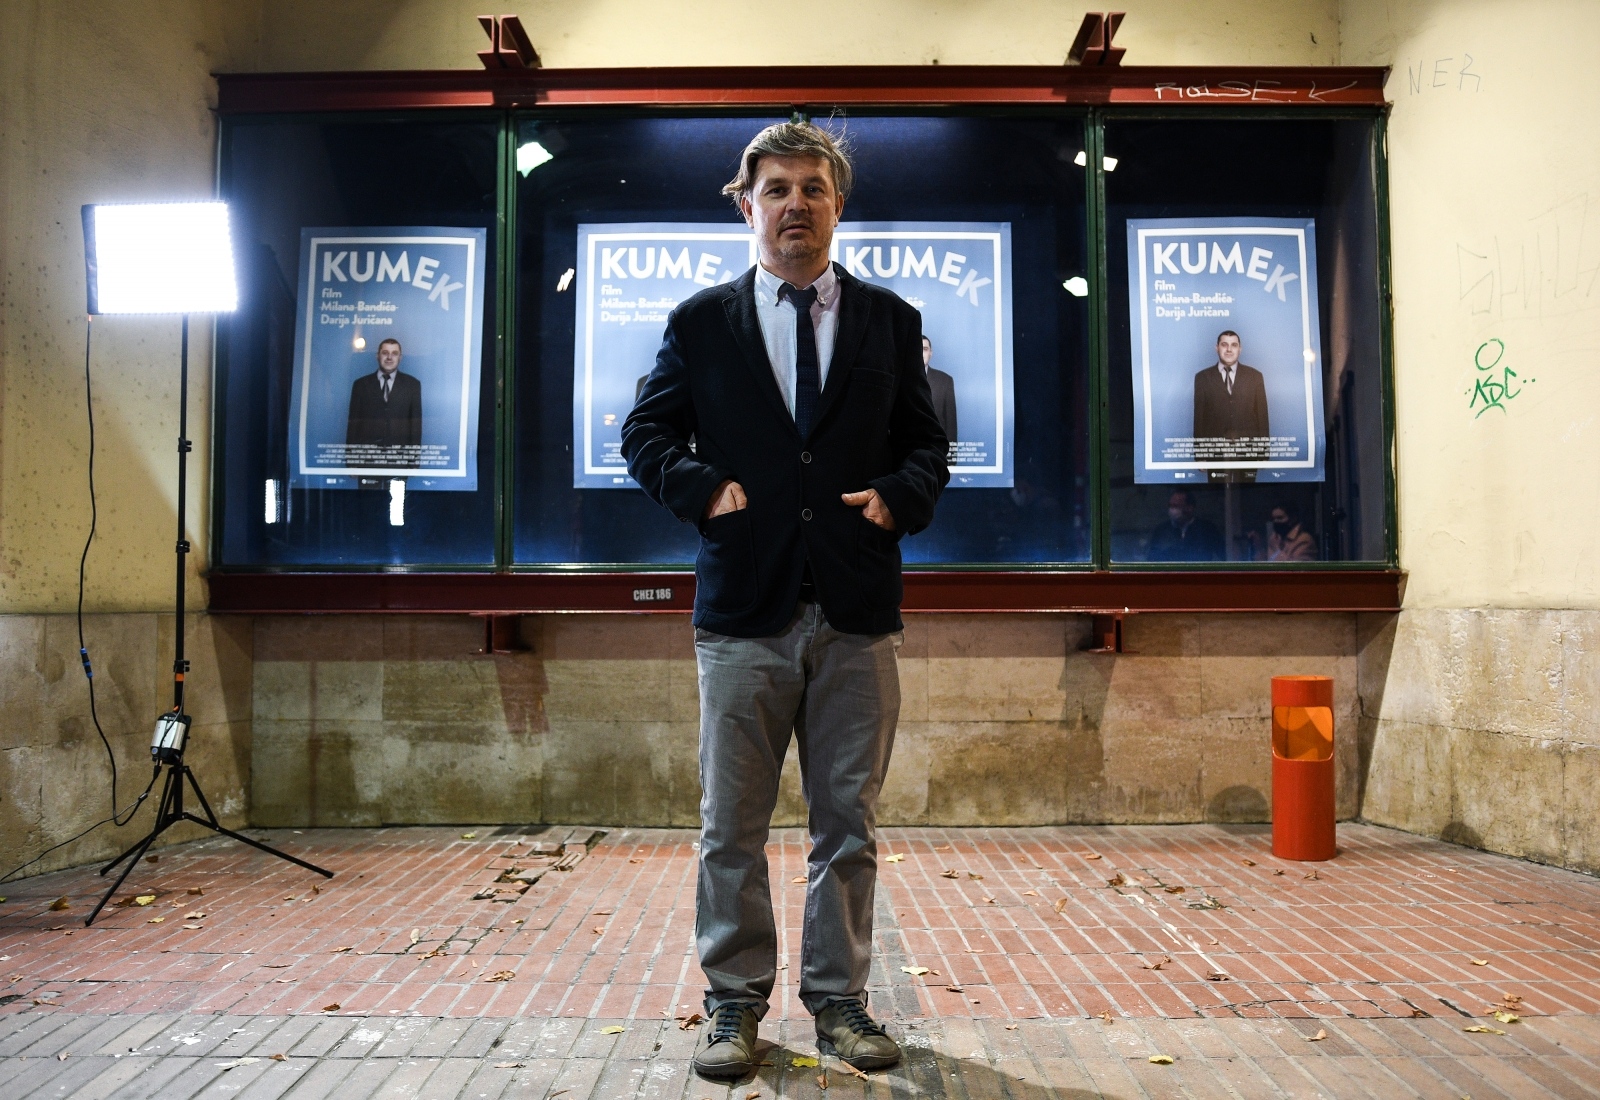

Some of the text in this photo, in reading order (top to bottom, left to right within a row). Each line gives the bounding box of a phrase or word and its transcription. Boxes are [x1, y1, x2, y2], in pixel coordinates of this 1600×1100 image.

[600, 246, 734, 286] KUME
[1153, 241, 1299, 302] KUMEK
[323, 250, 464, 311] KUMEK
[845, 246, 992, 307] KUMEK
[601, 285, 622, 295] film
[1155, 280, 1175, 290] film
[322, 288, 342, 298] film
[1155, 293, 1232, 303] Milana Bandića
[321, 301, 396, 311] Milana Bandića
[601, 298, 636, 308] Milana
[601, 311, 631, 326] Darija
[1156, 306, 1230, 321] Darija Juričana
[321, 314, 392, 328] Darija Juričana
[633, 588, 671, 601] CHEZ 186
